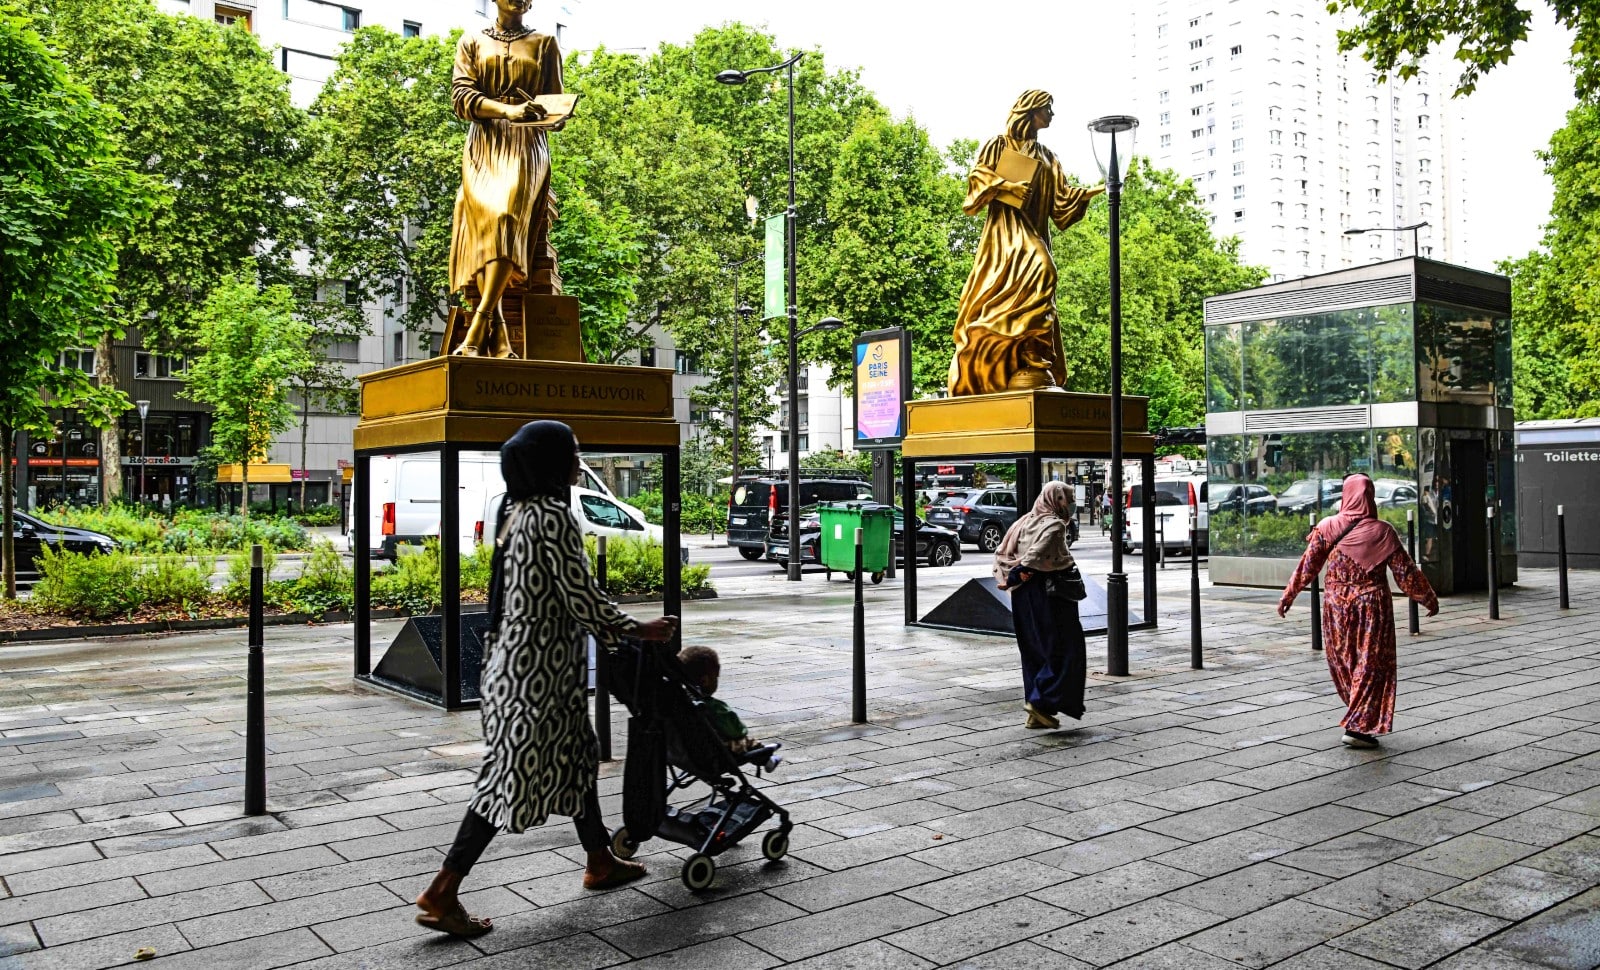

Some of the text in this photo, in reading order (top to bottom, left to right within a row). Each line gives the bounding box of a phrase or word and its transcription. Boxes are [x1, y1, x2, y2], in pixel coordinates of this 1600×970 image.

[868, 361, 888, 370] PARIS
[869, 370, 888, 378] SEINE
[475, 379, 647, 402] SIMONE DE BEAUVOIR
[1543, 451, 1600, 462] Toilette
